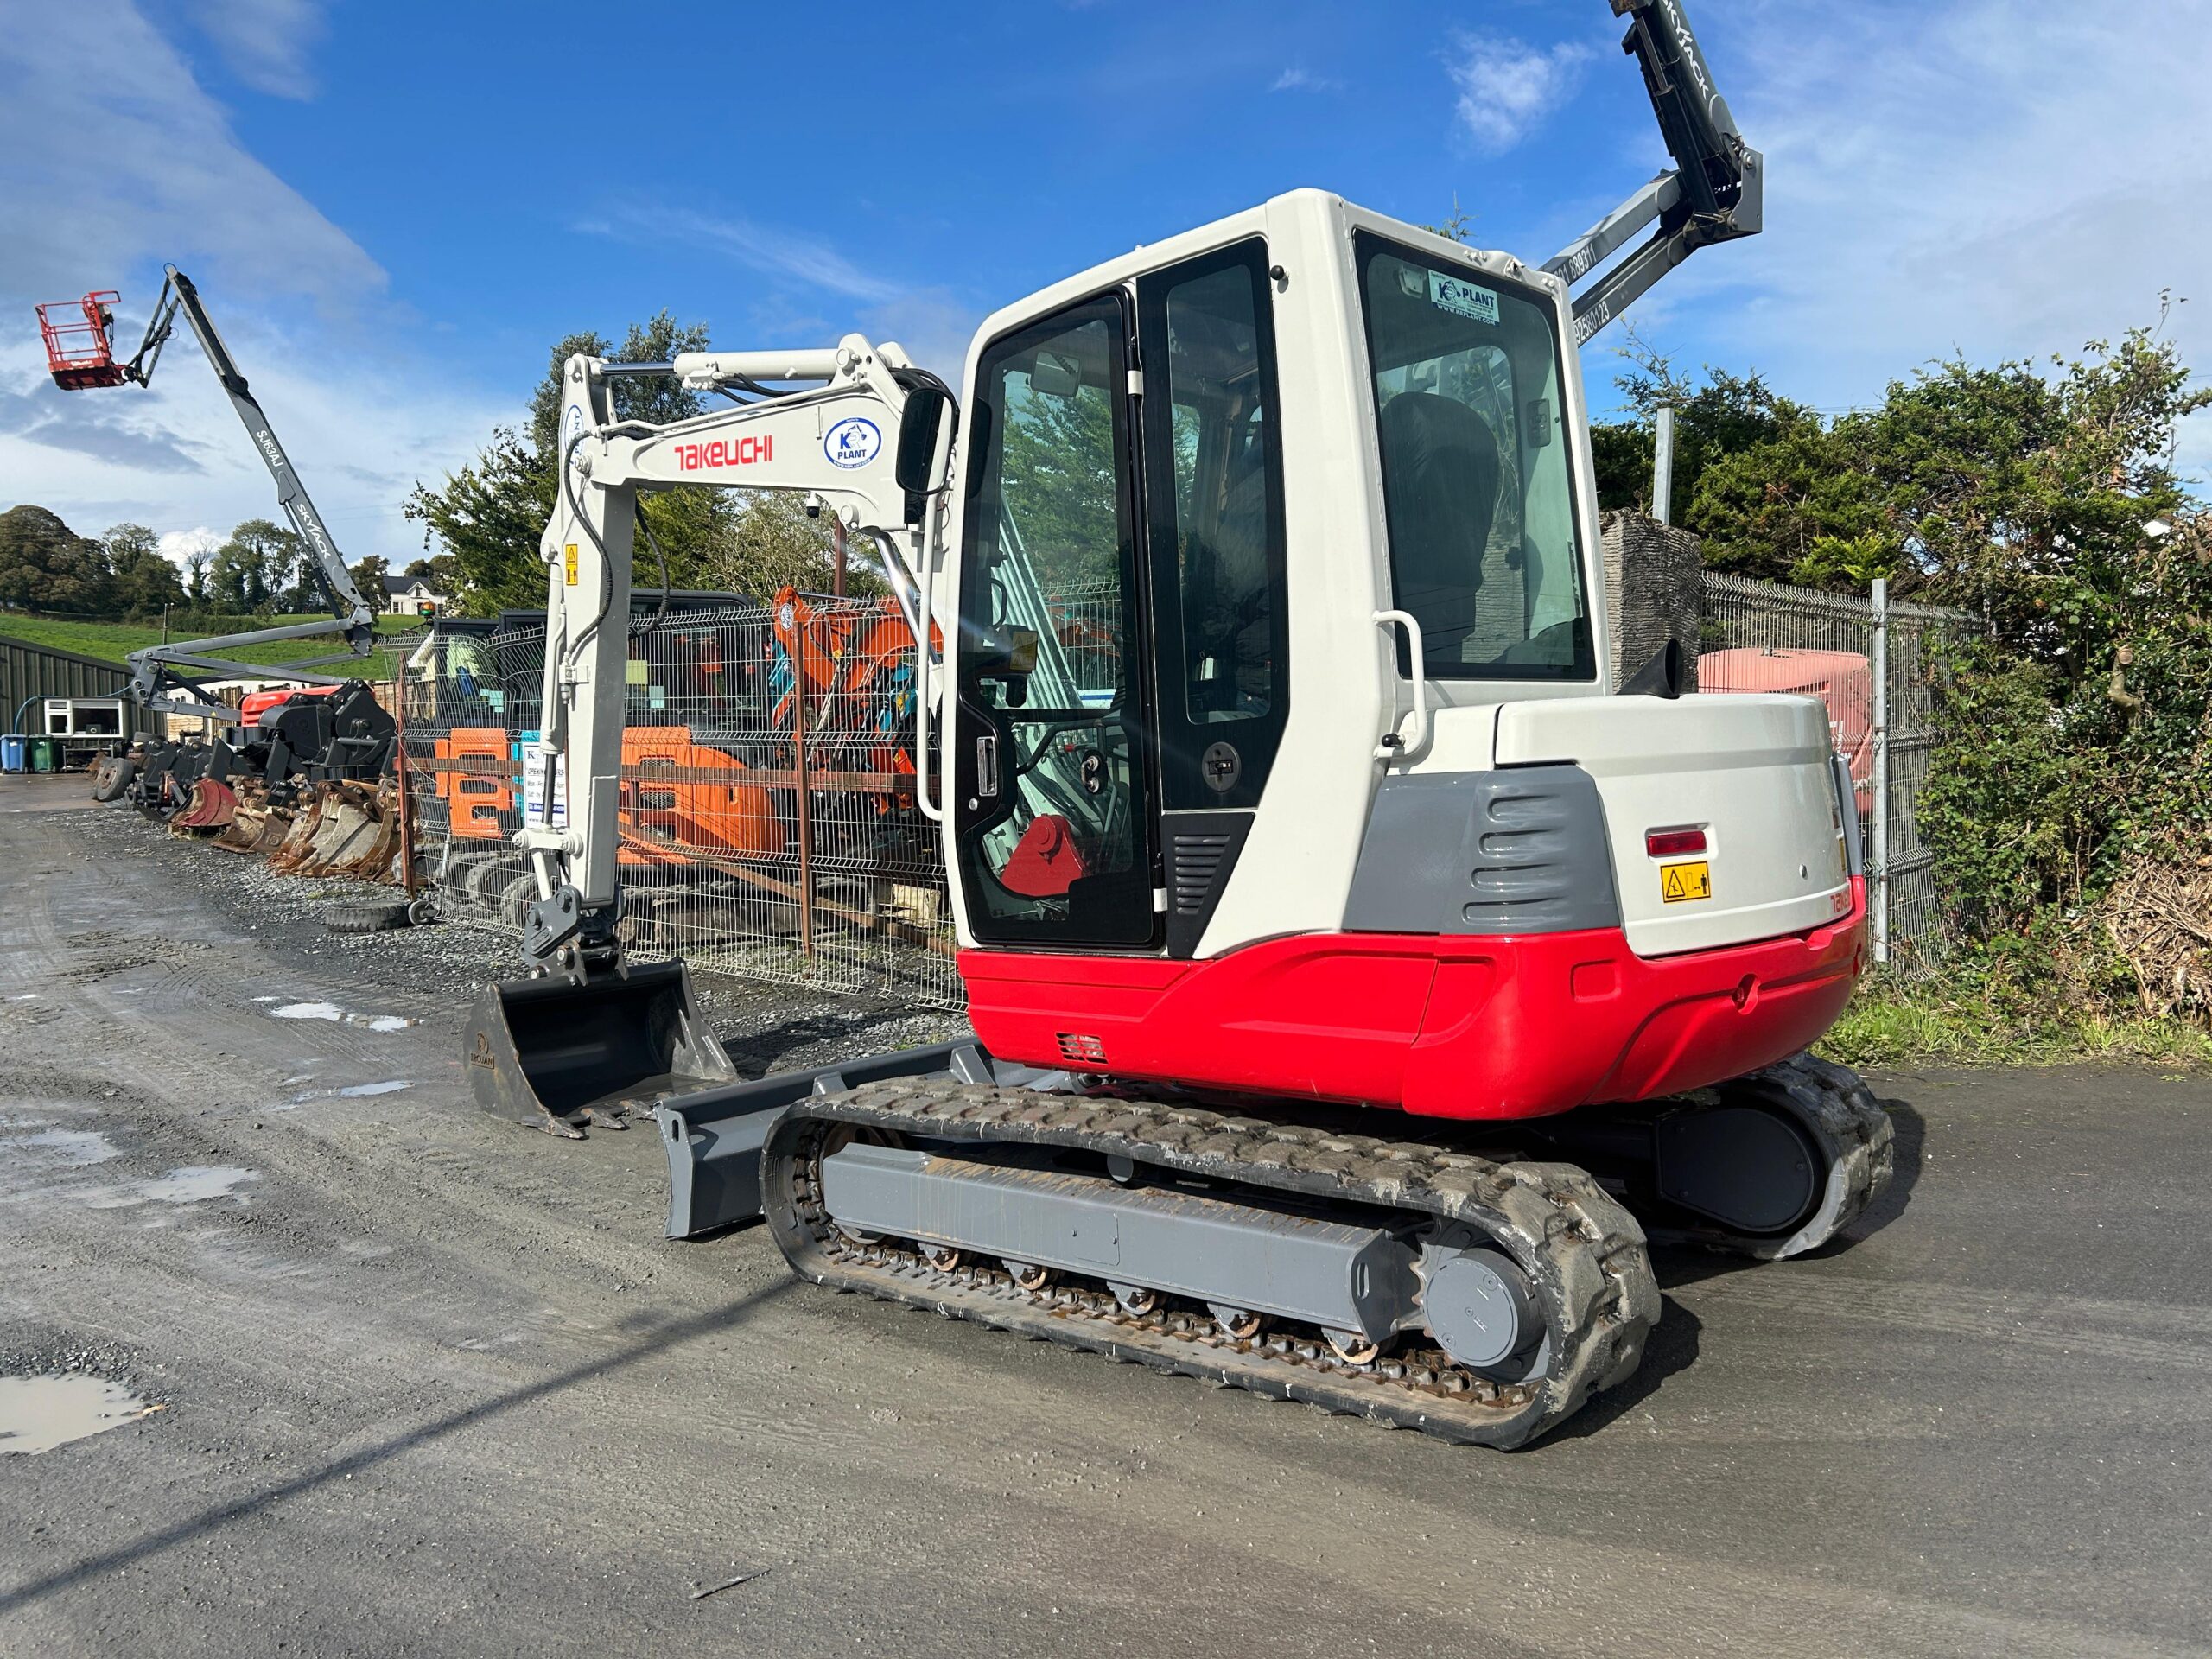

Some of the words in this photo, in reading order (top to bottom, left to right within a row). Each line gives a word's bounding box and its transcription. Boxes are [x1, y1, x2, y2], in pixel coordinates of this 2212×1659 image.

[1569, 243, 1597, 279] 889311
[1462, 287, 1494, 308] PLANT
[257, 430, 283, 467] SJ63AJ
[837, 449, 867, 460] PLANT
[296, 503, 331, 559] SKYJACK
[470, 1052, 493, 1065] TROJAN
